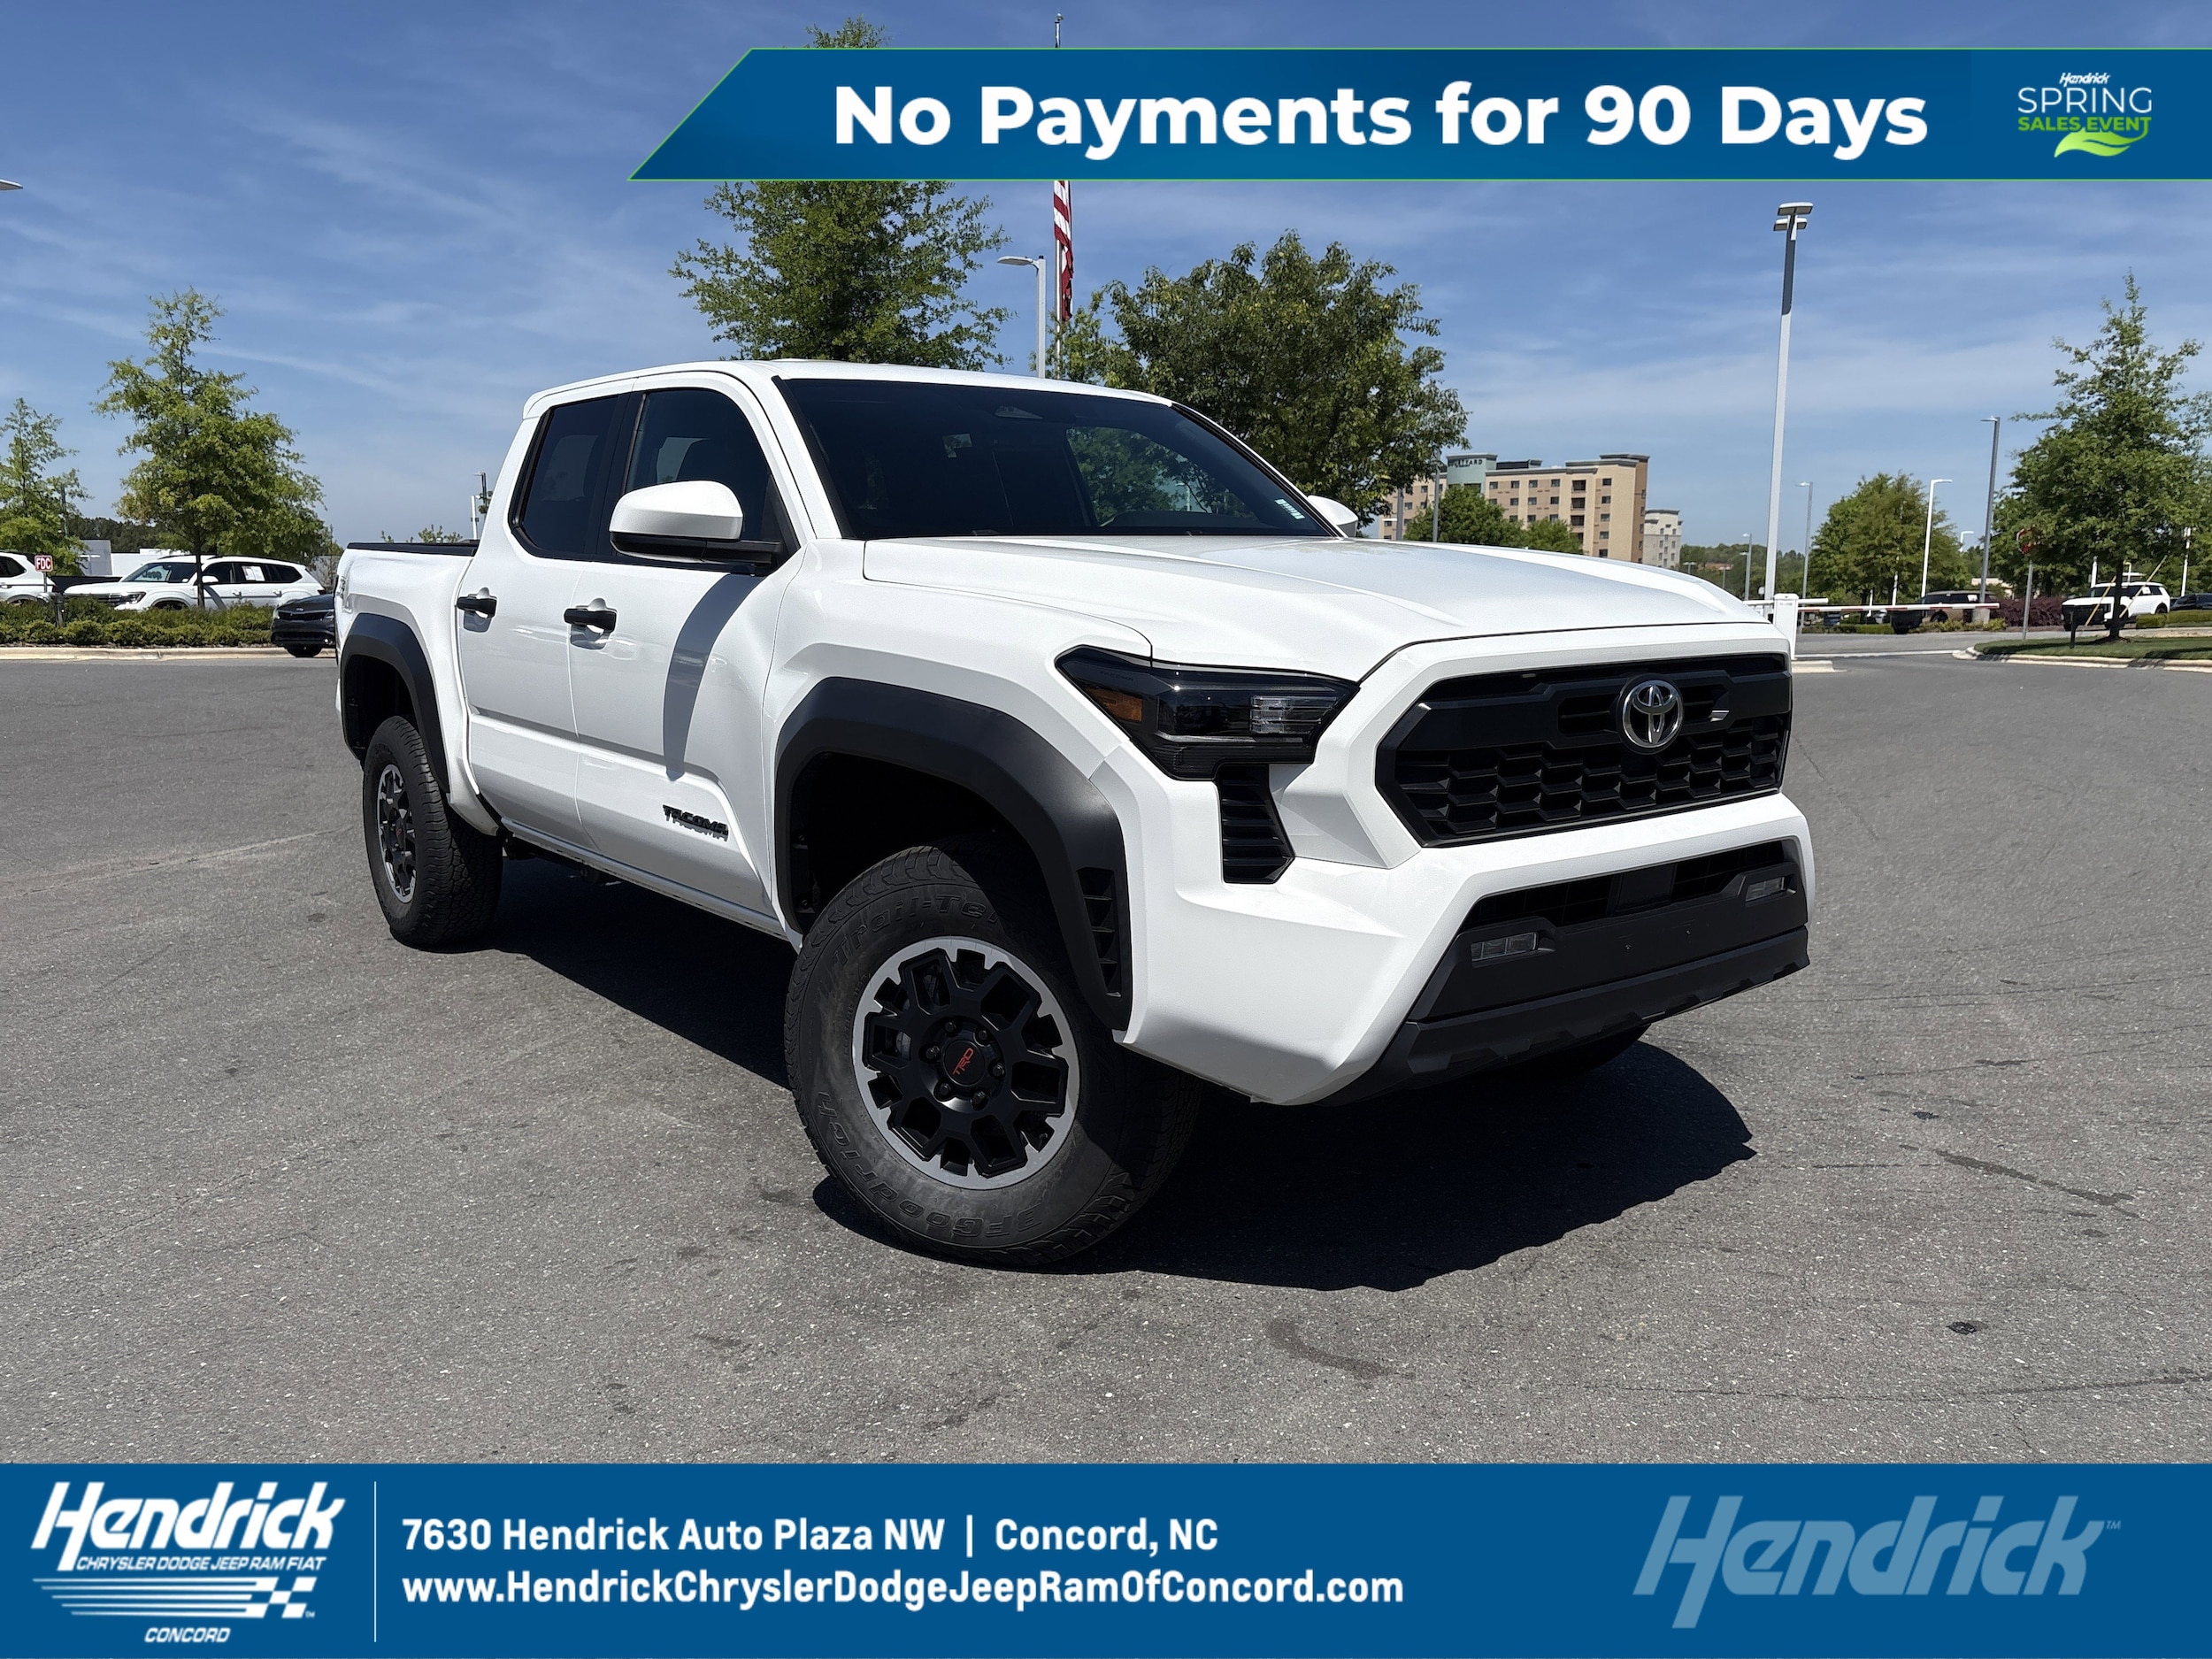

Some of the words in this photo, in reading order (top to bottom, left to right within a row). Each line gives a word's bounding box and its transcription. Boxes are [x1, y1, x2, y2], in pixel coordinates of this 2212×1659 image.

[36, 557, 51, 570] FDC
[662, 803, 729, 837] TACOMA
[952, 1047, 974, 1076] TRD
[816, 1091, 1044, 1238] BFGoodrich
